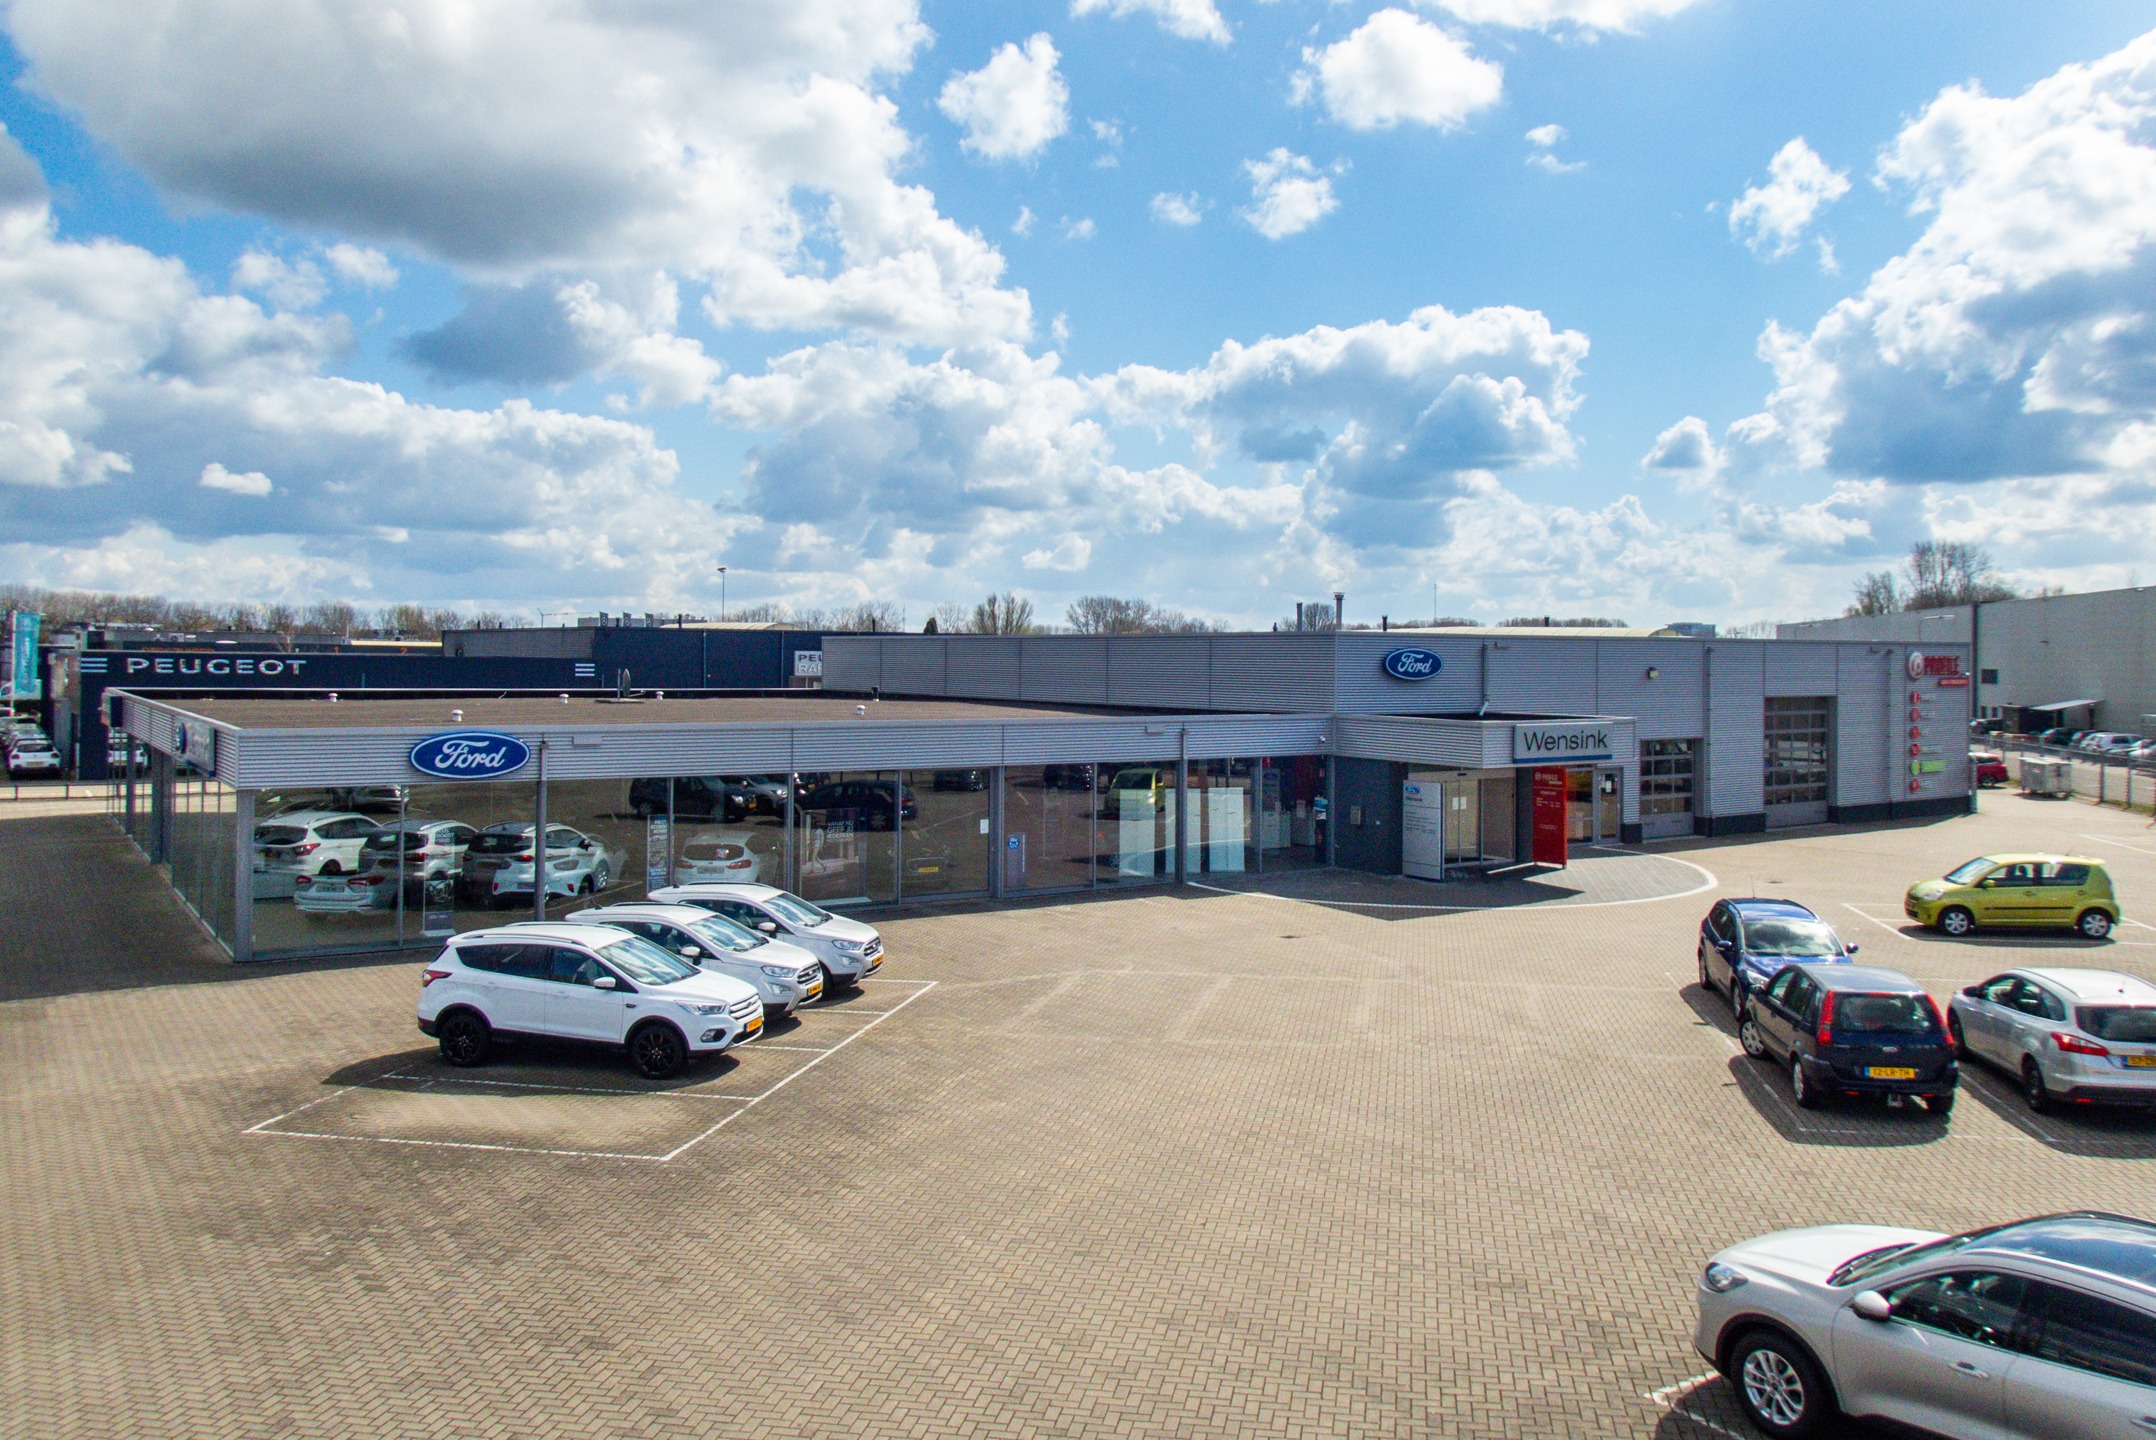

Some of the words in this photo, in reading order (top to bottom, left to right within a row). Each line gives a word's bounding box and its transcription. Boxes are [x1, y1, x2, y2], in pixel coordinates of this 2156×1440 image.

[126, 657, 307, 675] PEUGEOT
[1397, 652, 1433, 673] Ford
[1523, 729, 1608, 751] Wensink
[434, 740, 507, 768] Ford
